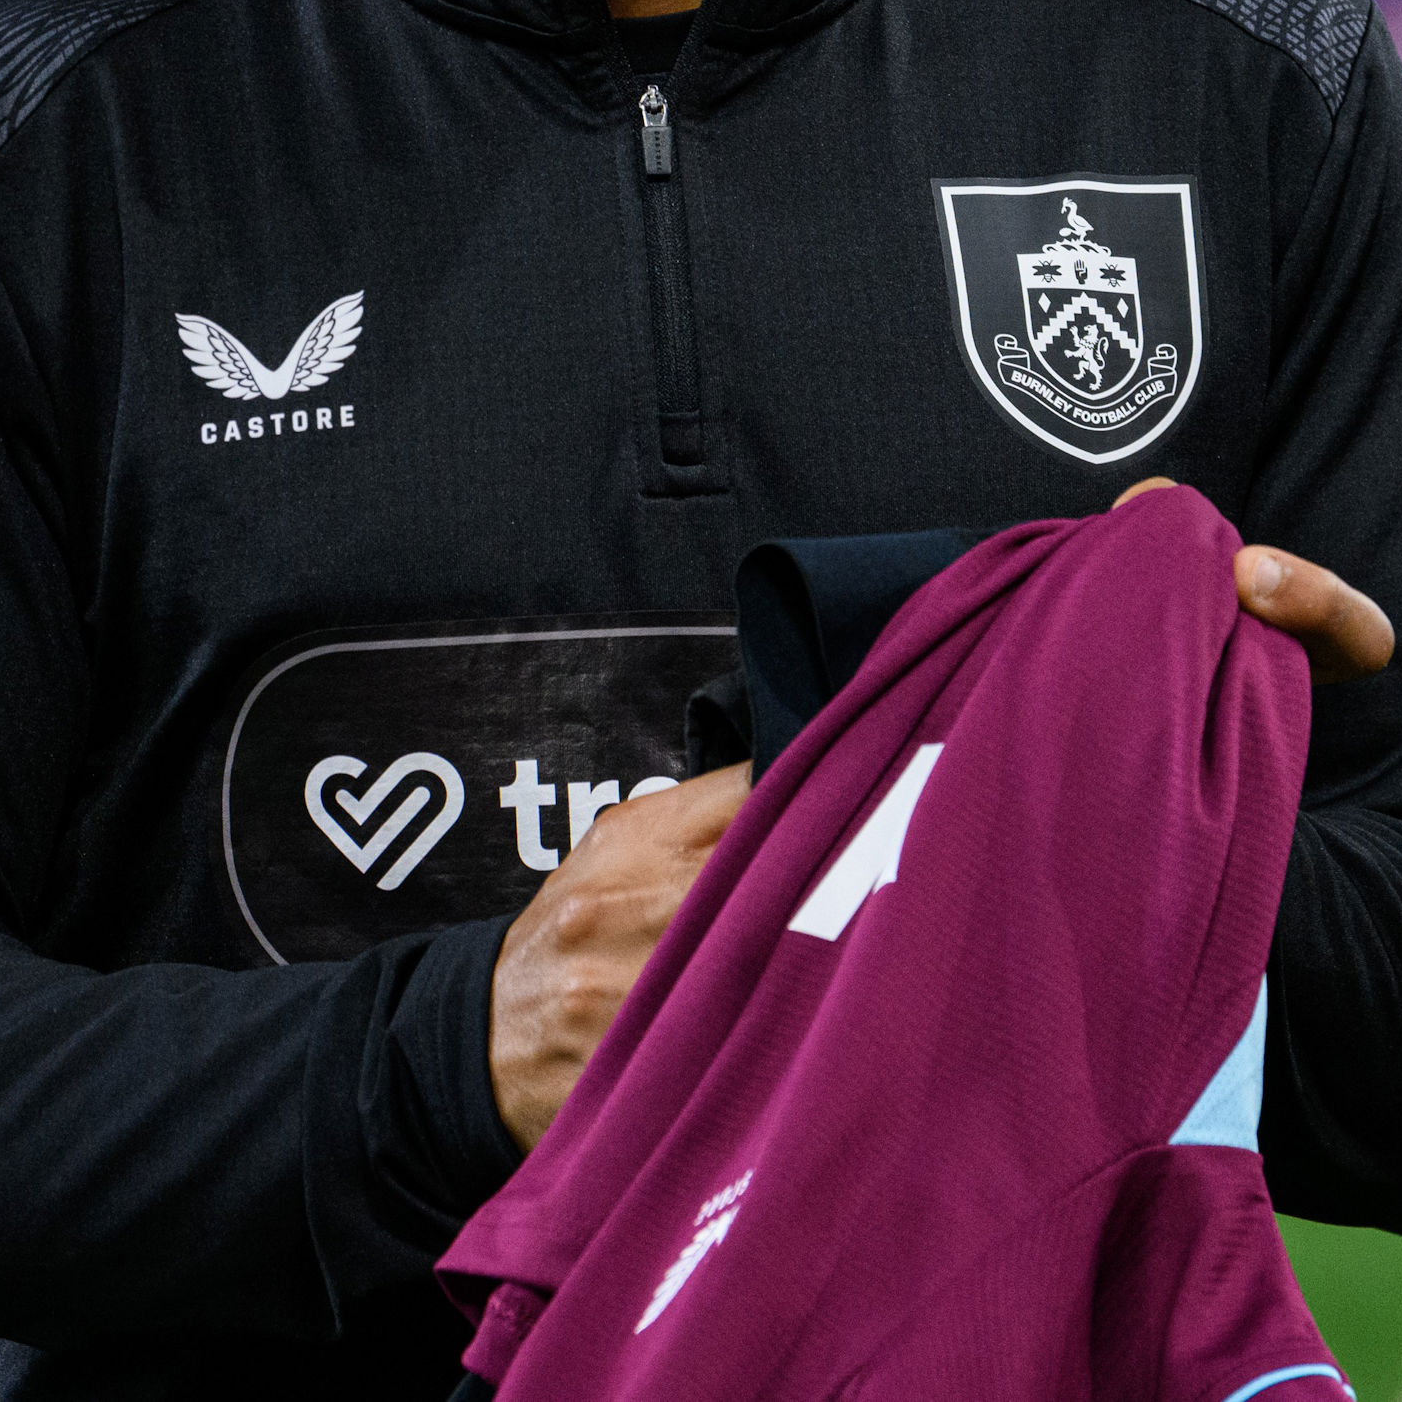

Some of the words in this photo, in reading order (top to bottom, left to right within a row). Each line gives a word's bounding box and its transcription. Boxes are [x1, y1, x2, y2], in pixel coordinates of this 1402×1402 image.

[200, 405, 355, 444] CASTORE
[1011, 370, 1073, 413] BURNLEY
[1072, 402, 1137, 425] FOOTBALL
[1134, 380, 1166, 405] CLUB
[499, 759, 681, 872] tr
